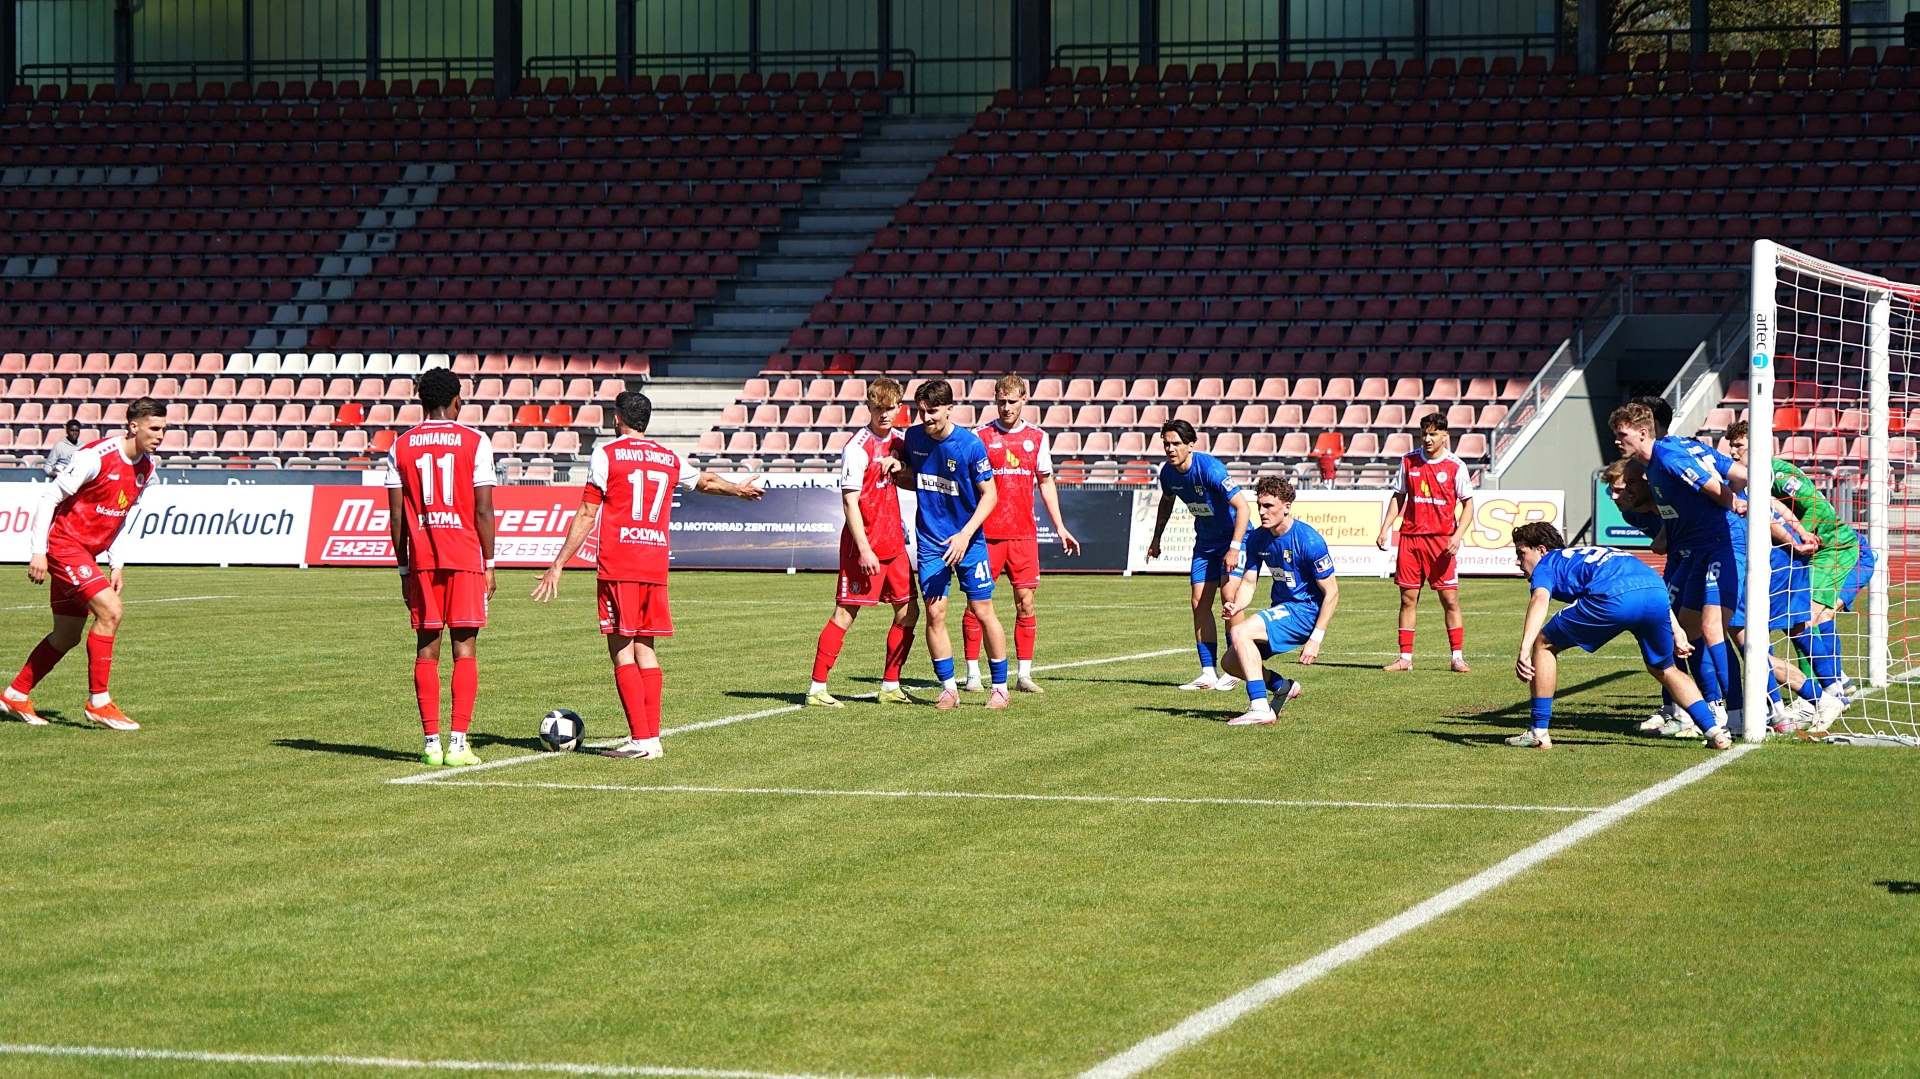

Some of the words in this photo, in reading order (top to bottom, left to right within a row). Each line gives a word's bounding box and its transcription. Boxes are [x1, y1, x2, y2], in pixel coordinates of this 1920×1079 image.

[1756, 313, 1769, 350] artec
[409, 432, 462, 447] BONIANGA
[614, 448, 644, 462] BRAVO
[415, 452, 455, 507] 11
[627, 468, 669, 523] 17
[1306, 513, 1347, 523] helfen
[620, 526, 667, 543] POLYMA
[683, 521, 744, 532] MOTORRAD
[744, 522, 796, 533] ZENTRUM
[796, 522, 836, 533] KASSEL
[1336, 527, 1369, 539] jetzt.
[974, 559, 991, 581] 41
